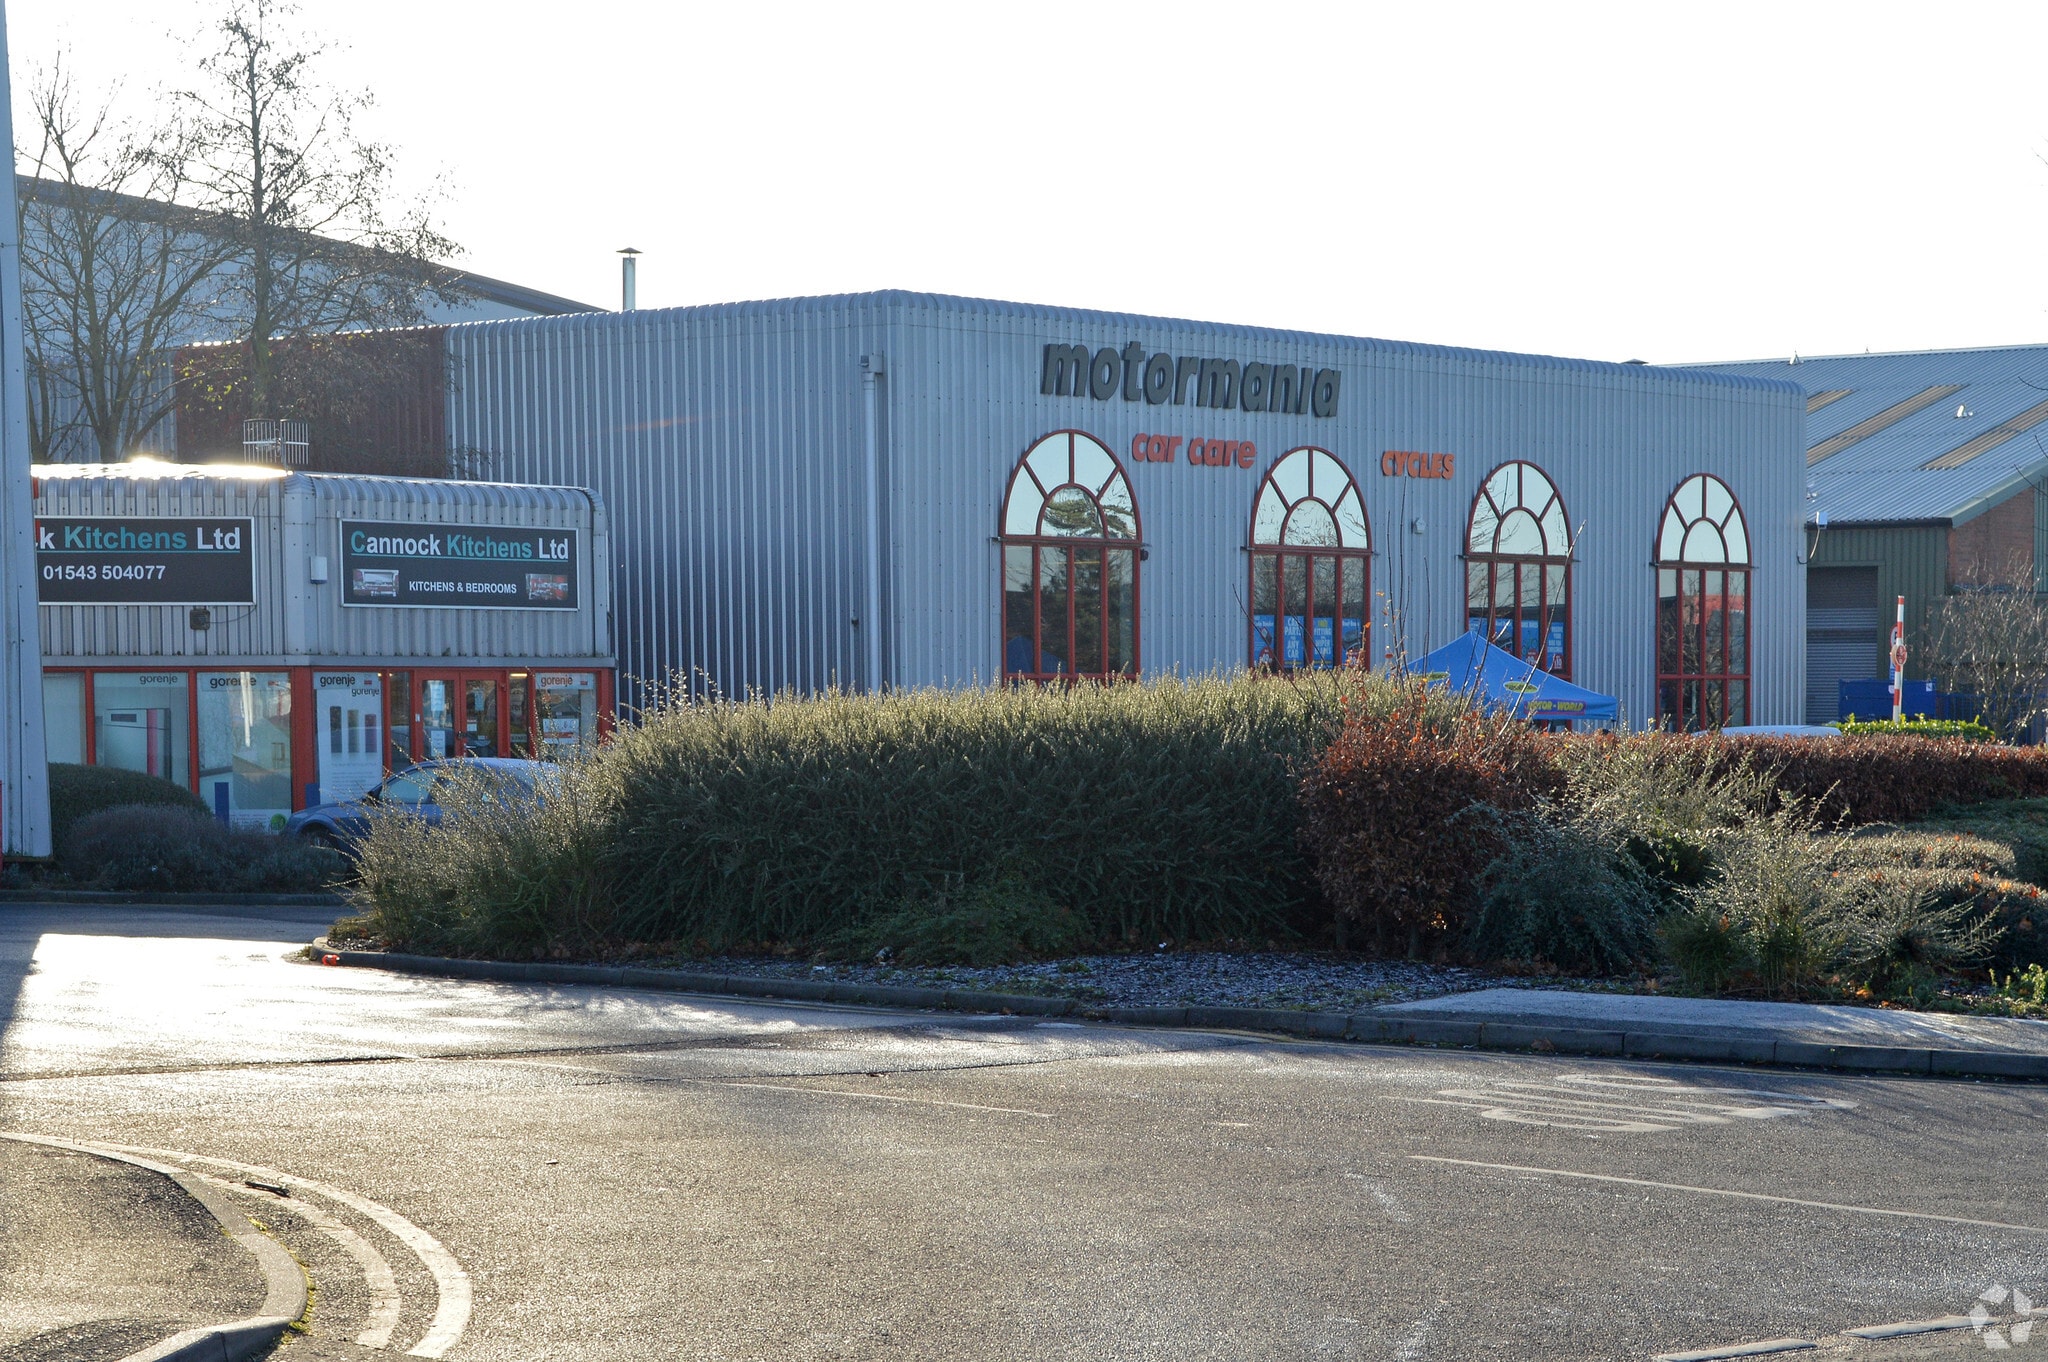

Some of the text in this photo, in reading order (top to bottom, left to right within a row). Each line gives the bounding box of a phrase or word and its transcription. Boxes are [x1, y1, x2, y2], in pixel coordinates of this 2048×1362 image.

[1040, 340, 1342, 418] motormania
[1132, 432, 1256, 469] car care
[1381, 450, 1455, 480] CYCLES
[36, 525, 241, 550] k Kitchens Ltd
[350, 530, 569, 560] Cannock Kitchens Ltd
[43, 565, 166, 580] 01543 504077
[409, 580, 518, 594] KITCHENS & BEDROOMS
[140, 674, 178, 685] gorenje
[320, 674, 356, 687] gorenje
[541, 674, 573, 688] gorenje
